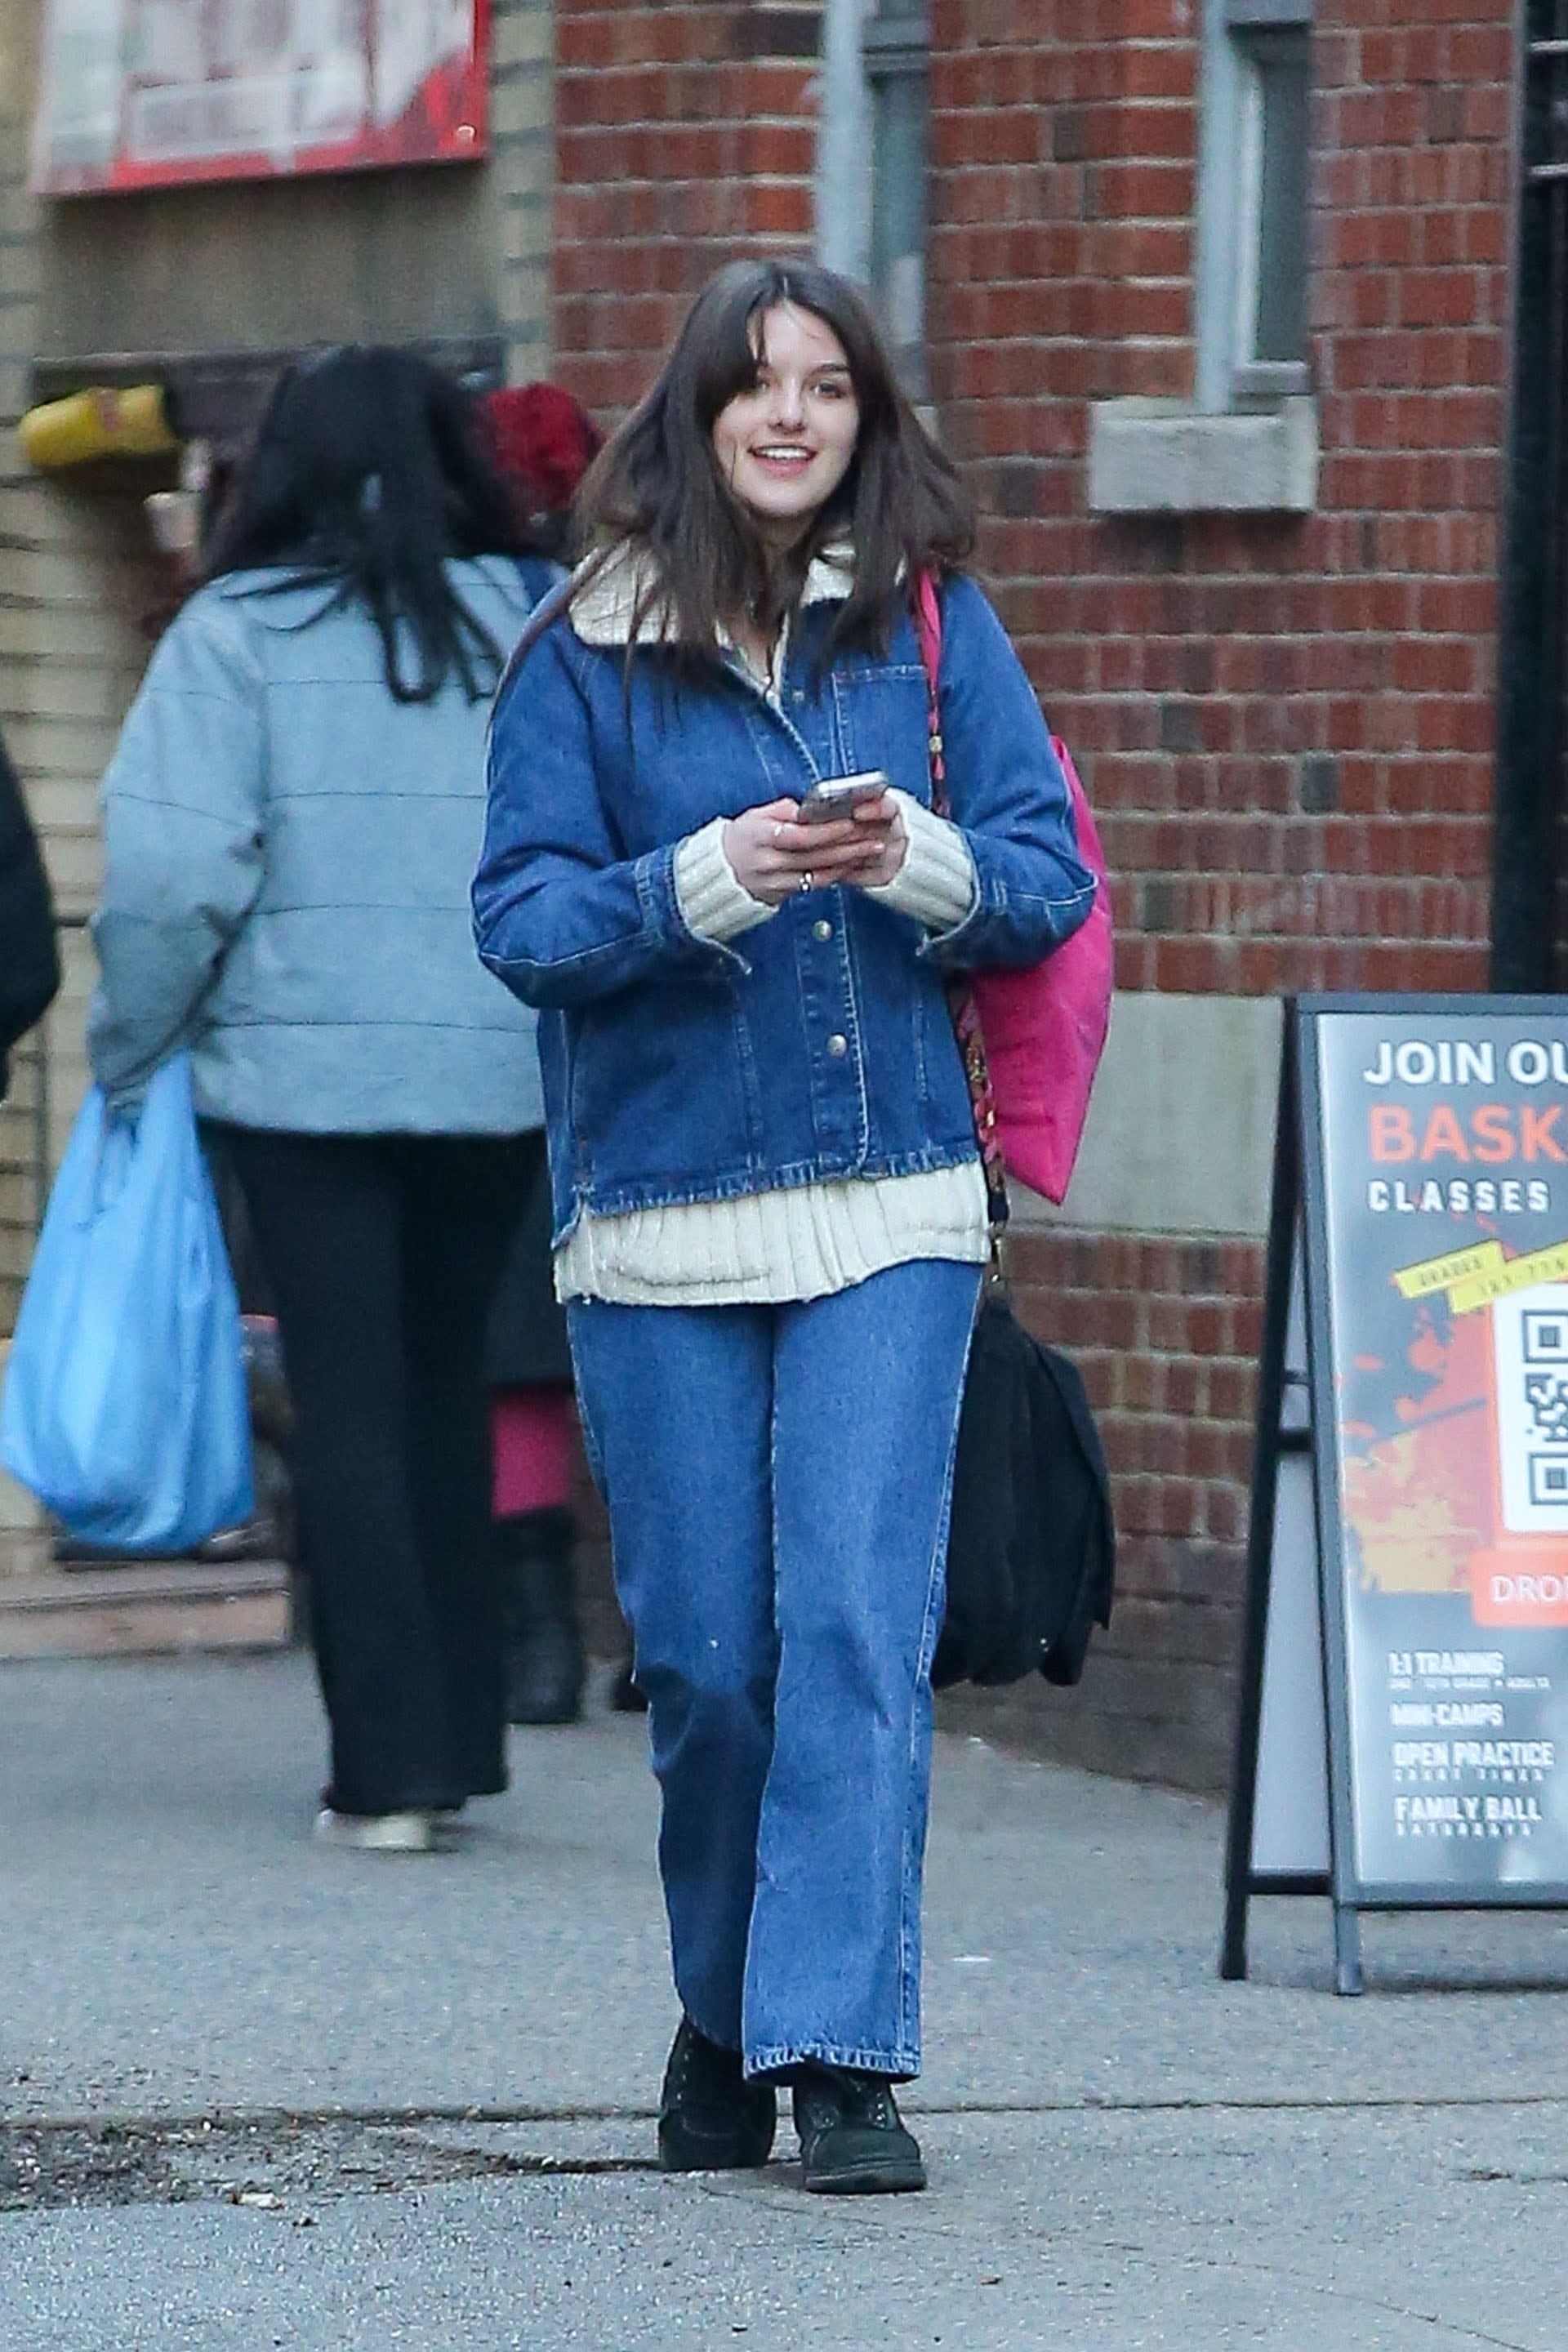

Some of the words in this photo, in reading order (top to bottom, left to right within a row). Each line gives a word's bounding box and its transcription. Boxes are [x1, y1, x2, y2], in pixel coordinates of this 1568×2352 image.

[1364, 1041, 1495, 1085] JOIN
[1369, 1103, 1567, 1164] BASK
[1367, 1180, 1550, 1213] CLASSES
[1415, 1650, 1504, 1675] TRAINING
[1393, 1741, 1449, 1766] OPEN
[1452, 1741, 1554, 1766] PRACTICE
[1395, 1796, 1479, 1821] FAMILY
[1485, 1796, 1542, 1821] BALL
